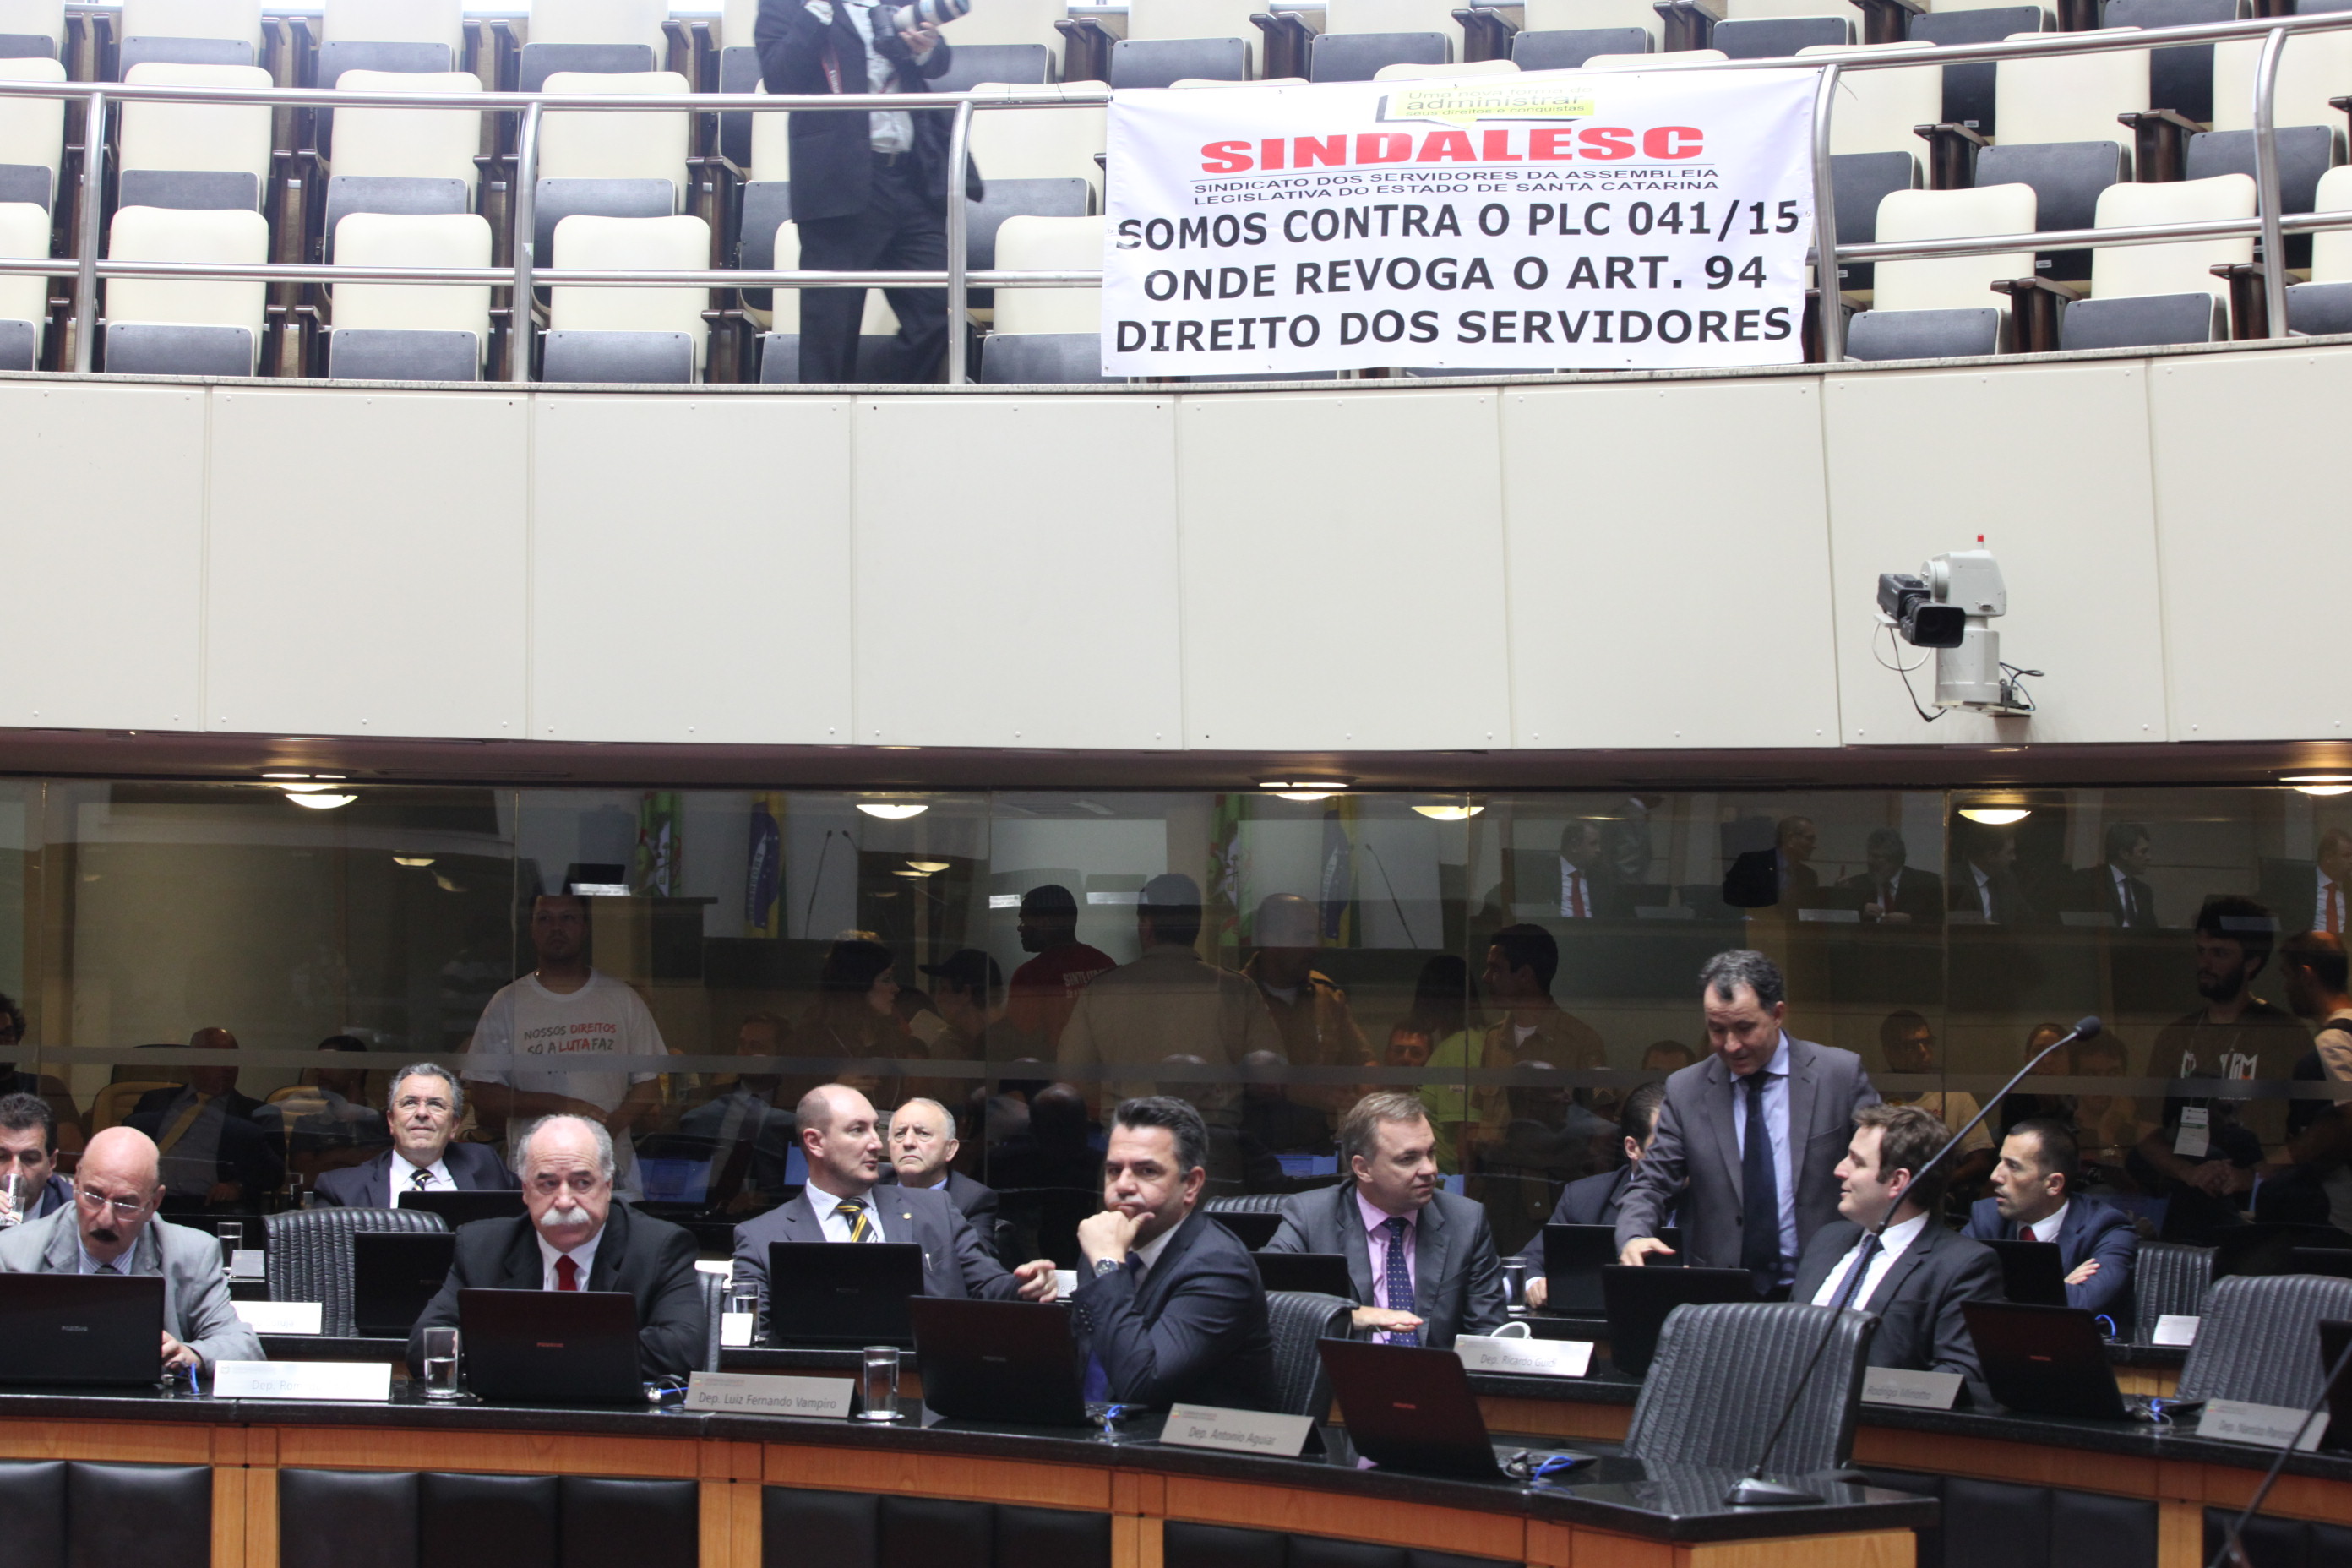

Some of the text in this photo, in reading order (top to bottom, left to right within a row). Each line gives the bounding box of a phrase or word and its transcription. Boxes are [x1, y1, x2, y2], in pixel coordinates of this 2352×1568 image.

[1407, 94, 1584, 111] administrar
[1408, 91, 1451, 100] Uma
[1458, 90, 1503, 98] nova
[1511, 87, 1564, 96] forma
[1442, 107, 1492, 116] direitos
[1510, 105, 1585, 114] conquistas
[1200, 126, 1704, 174] SINDALESC
[1194, 169, 1719, 193] SINDICATO DOS SERVIDORES DA ASSEMBLEIA
[1194, 181, 1720, 205] LEGISLATIVA DO ESTADO DE SANTA CATARINA
[1115, 199, 1799, 251] SOMOS CONTRA O PLC 041/15
[1143, 254, 1767, 302] ONDE REVOGA O ART. 94
[1116, 306, 1793, 353] DIREITO DOS SERVIDORES
[524, 1022, 618, 1041] NOSSOS DIREITOS
[547, 1041, 557, 1054] A
[558, 1037, 591, 1053] LUTA
[591, 1037, 615, 1051] FAZ
[1480, 1353, 1499, 1366] Dep.
[1501, 1355, 1533, 1366] Ricardo
[252, 1380, 275, 1392] Dep.
[699, 1391, 837, 1410] Dep. Luiz Fernando Vampiro
[1188, 1425, 1207, 1440] Dep.
[1211, 1429, 1245, 1442] Antonio
